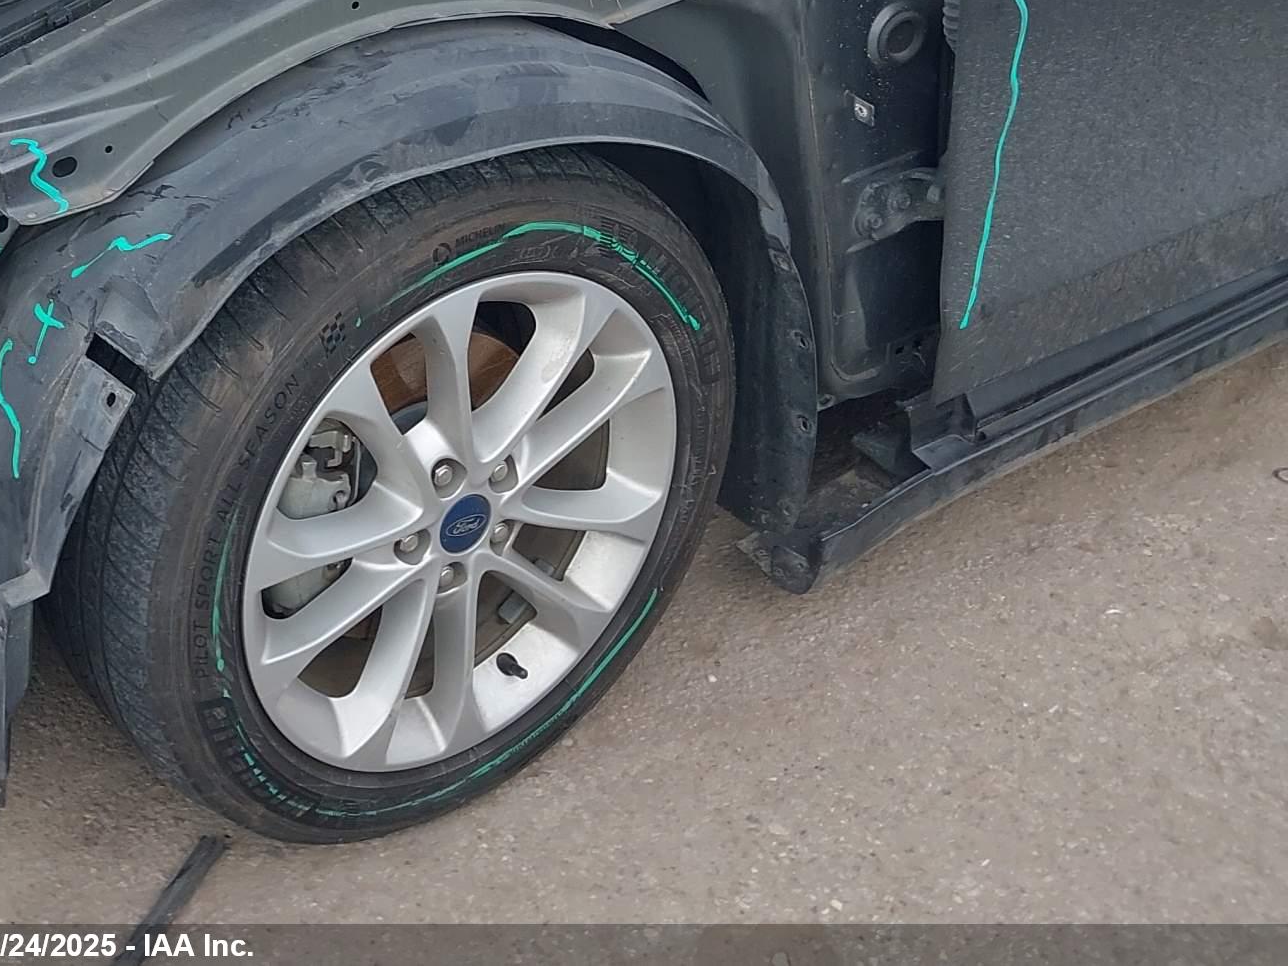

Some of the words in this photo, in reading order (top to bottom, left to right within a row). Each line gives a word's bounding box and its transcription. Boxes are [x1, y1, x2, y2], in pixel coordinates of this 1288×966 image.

[455, 223, 506, 247] MICHELIN
[238, 373, 300, 468] SEASON
[216, 482, 242, 523] ALL
[452, 517, 480, 535] Ford
[196, 537, 222, 611] SPORT
[194, 620, 210, 679] PILOT
